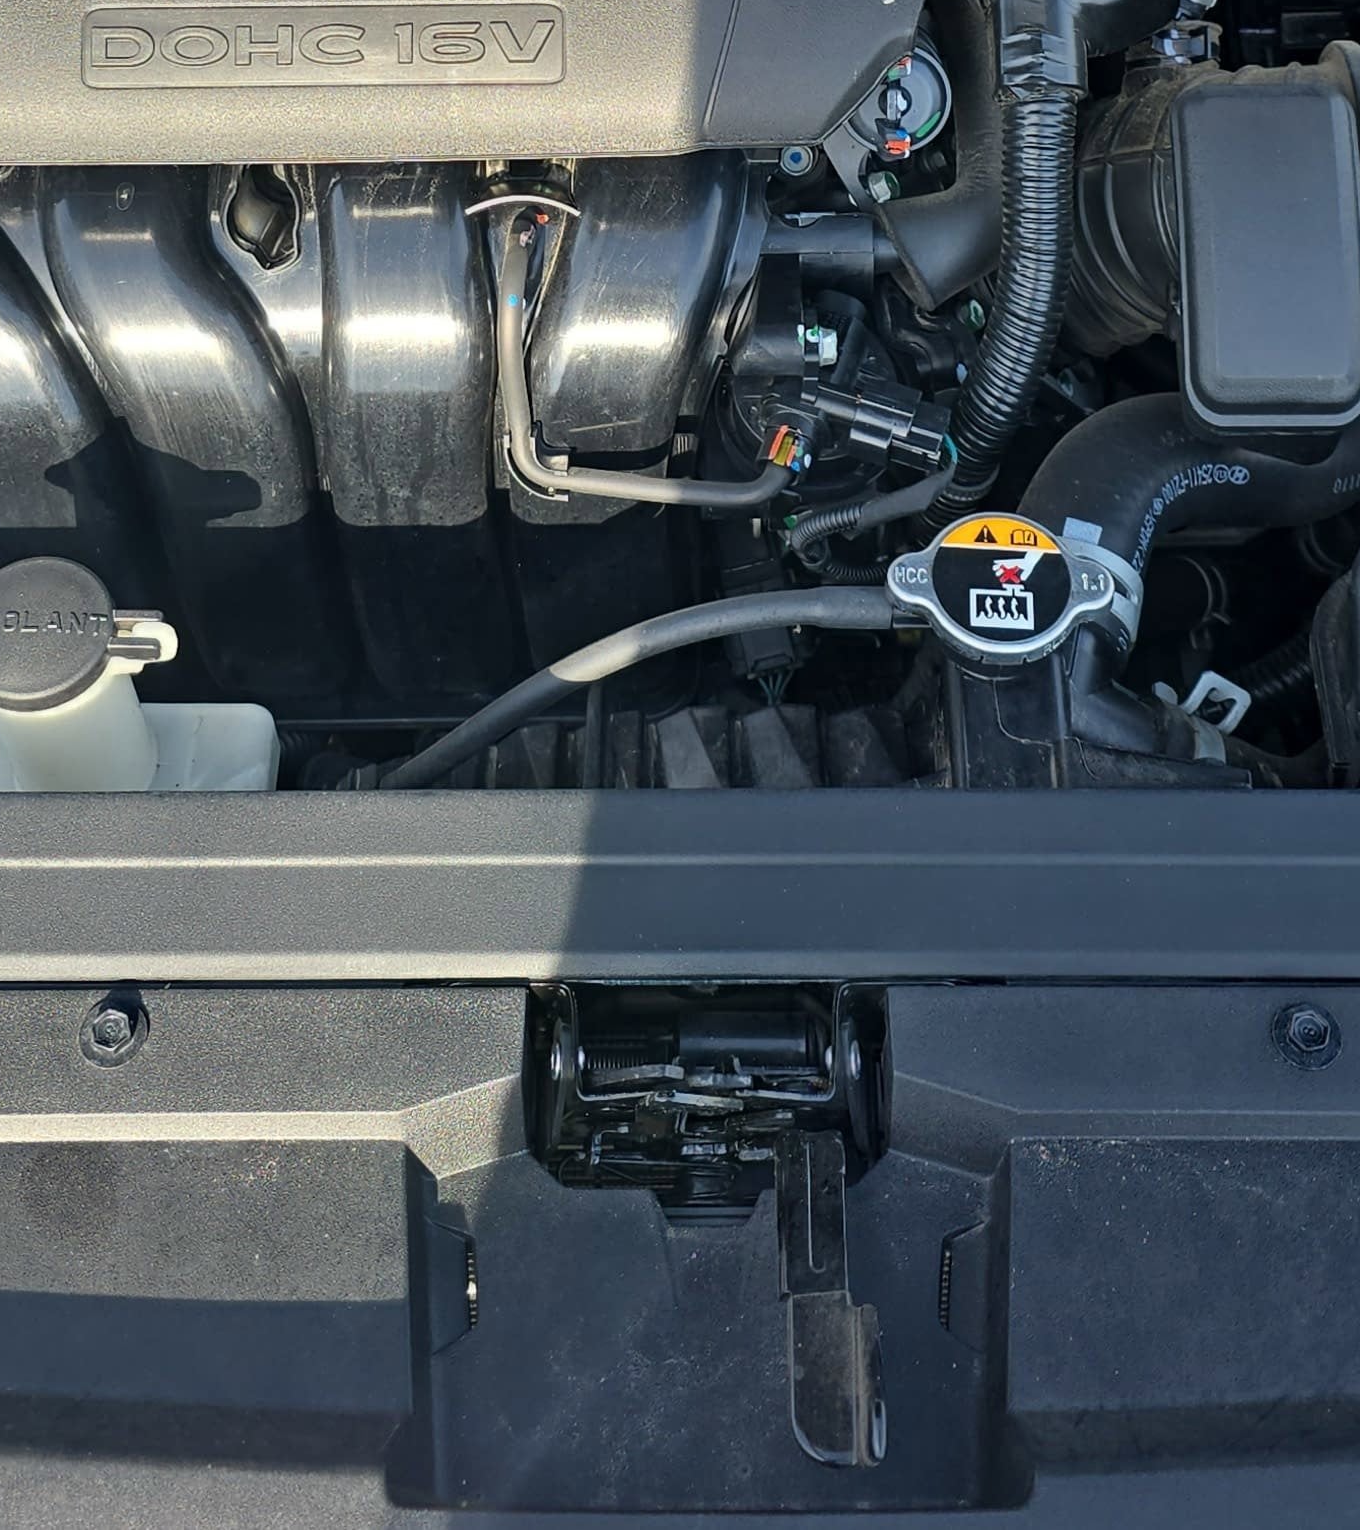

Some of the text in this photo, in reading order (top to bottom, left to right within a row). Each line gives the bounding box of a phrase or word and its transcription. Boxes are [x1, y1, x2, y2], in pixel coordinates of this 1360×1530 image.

[91, 20, 556, 69] DOHC 16V
[894, 566, 1106, 591] HCC 1.1
